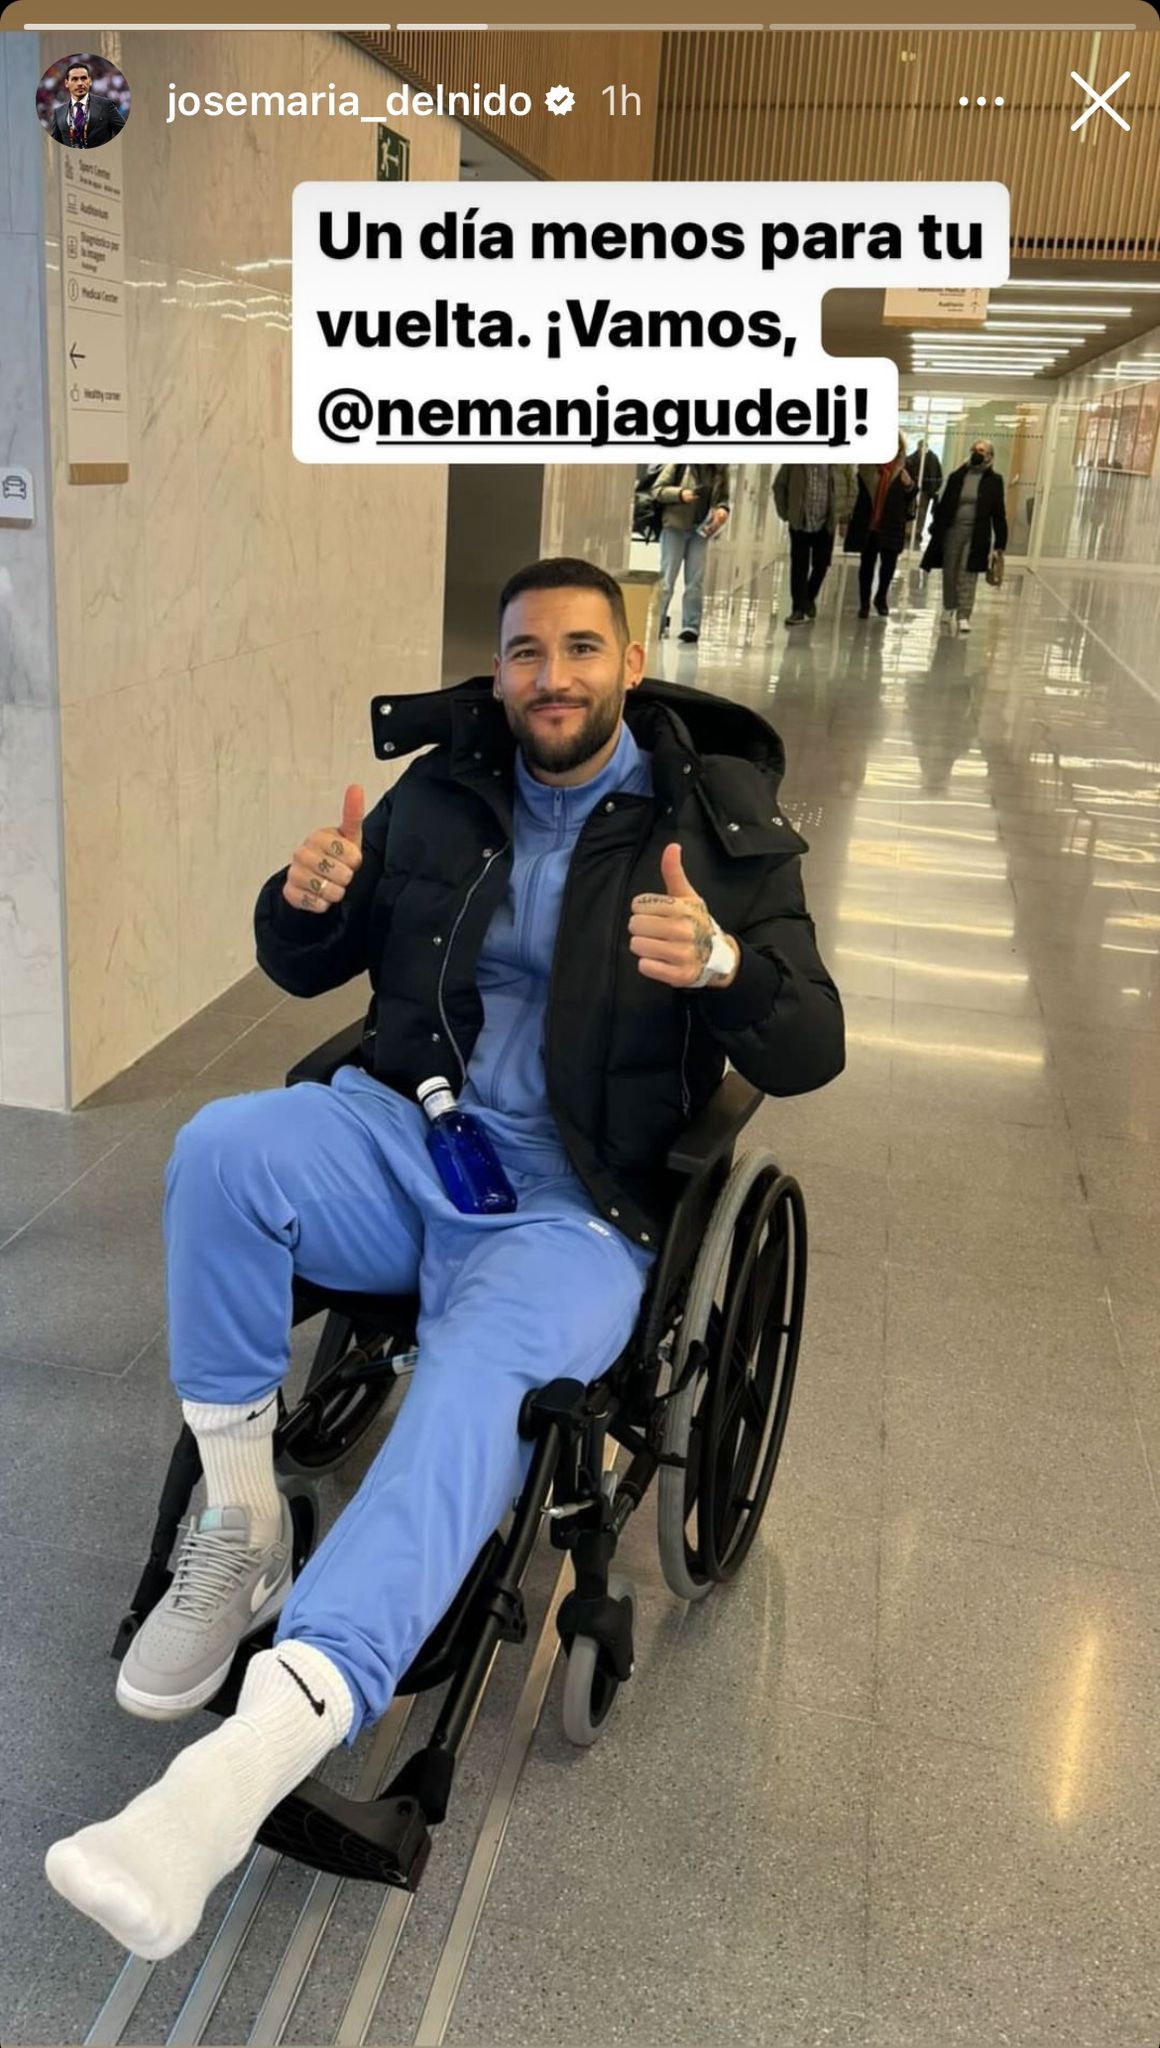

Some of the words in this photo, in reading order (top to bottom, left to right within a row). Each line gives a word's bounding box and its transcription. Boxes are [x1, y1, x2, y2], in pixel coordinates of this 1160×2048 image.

[79, 159, 94, 174] Sport
[81, 201, 108, 220] Auditorium
[87, 249, 105, 263] imagen
[82, 287, 101, 300] Medical
[102, 290, 118, 303] Center
[84, 388, 104, 403] Healthy
